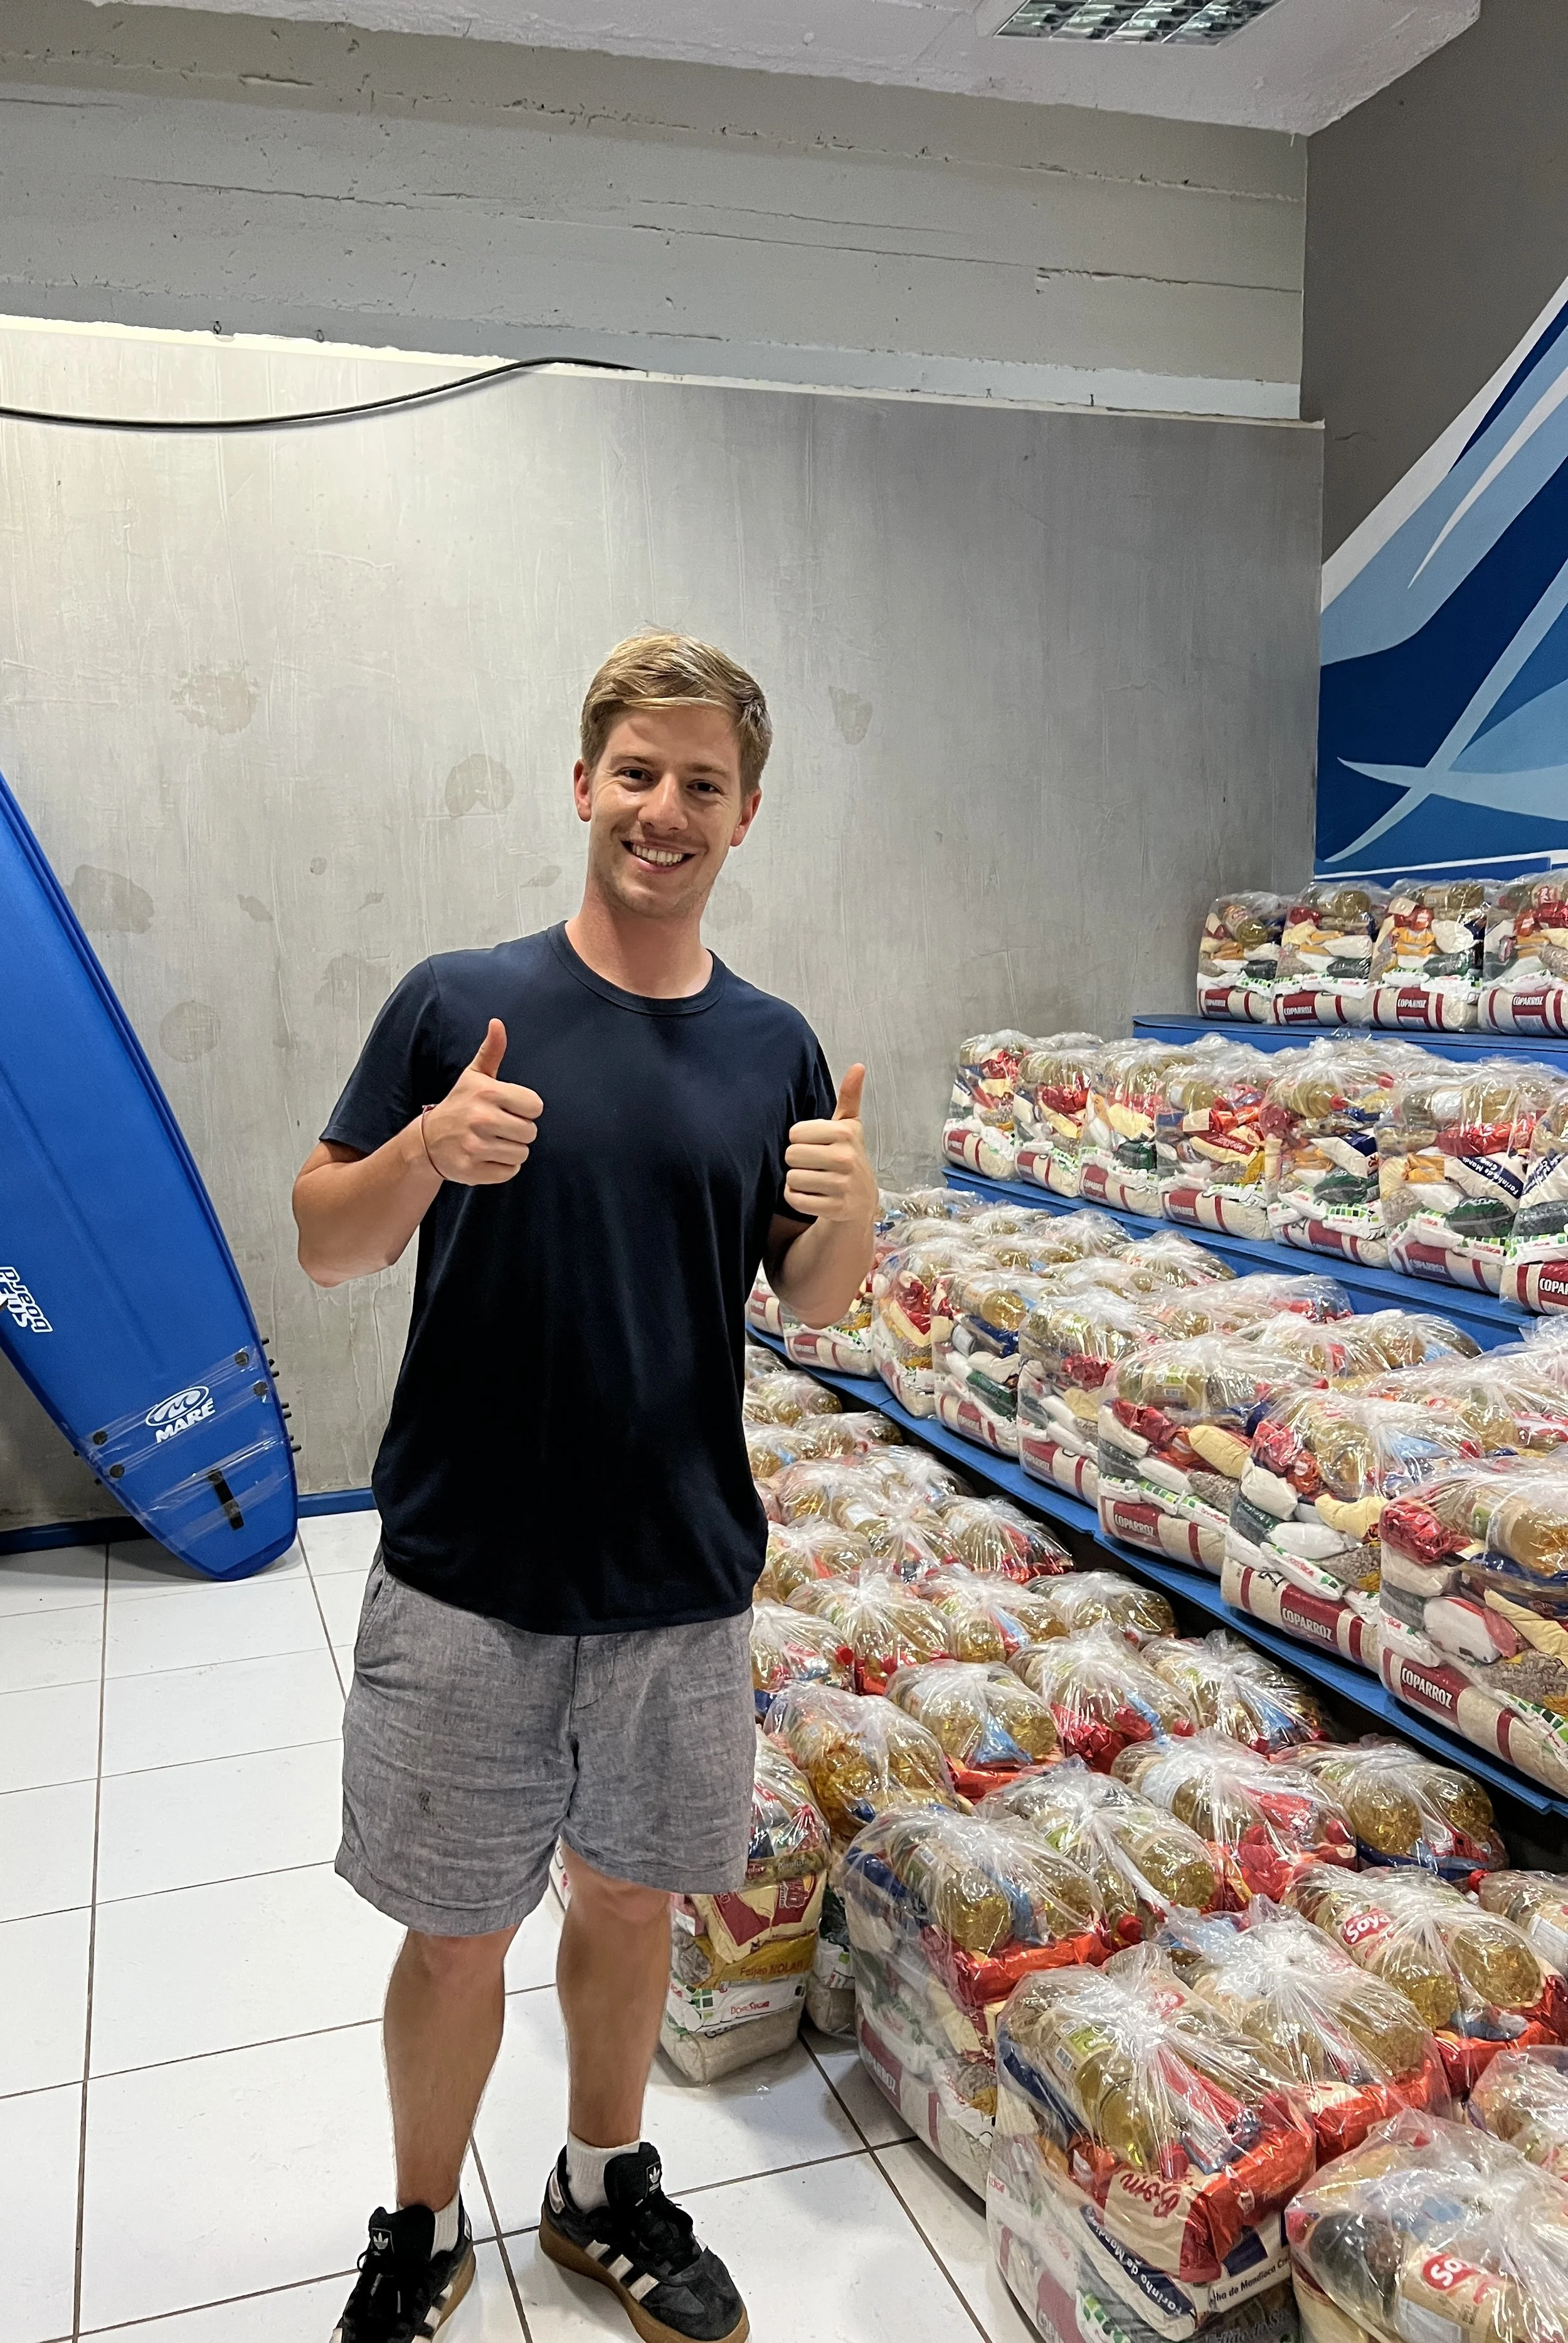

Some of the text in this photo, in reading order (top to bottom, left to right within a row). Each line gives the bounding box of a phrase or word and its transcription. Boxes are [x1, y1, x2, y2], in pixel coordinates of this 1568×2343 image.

[155, 1397, 216, 1444] MARÉ
[1114, 1514, 1155, 1537] COPARROZ
[1281, 1607, 1334, 1642] COPARROZ
[1401, 1667, 1453, 1710] COPARROZ
[1346, 1913, 1392, 1944] Soya
[1126, 2258, 1139, 2275] de
[1430, 2258, 1466, 2287] So
